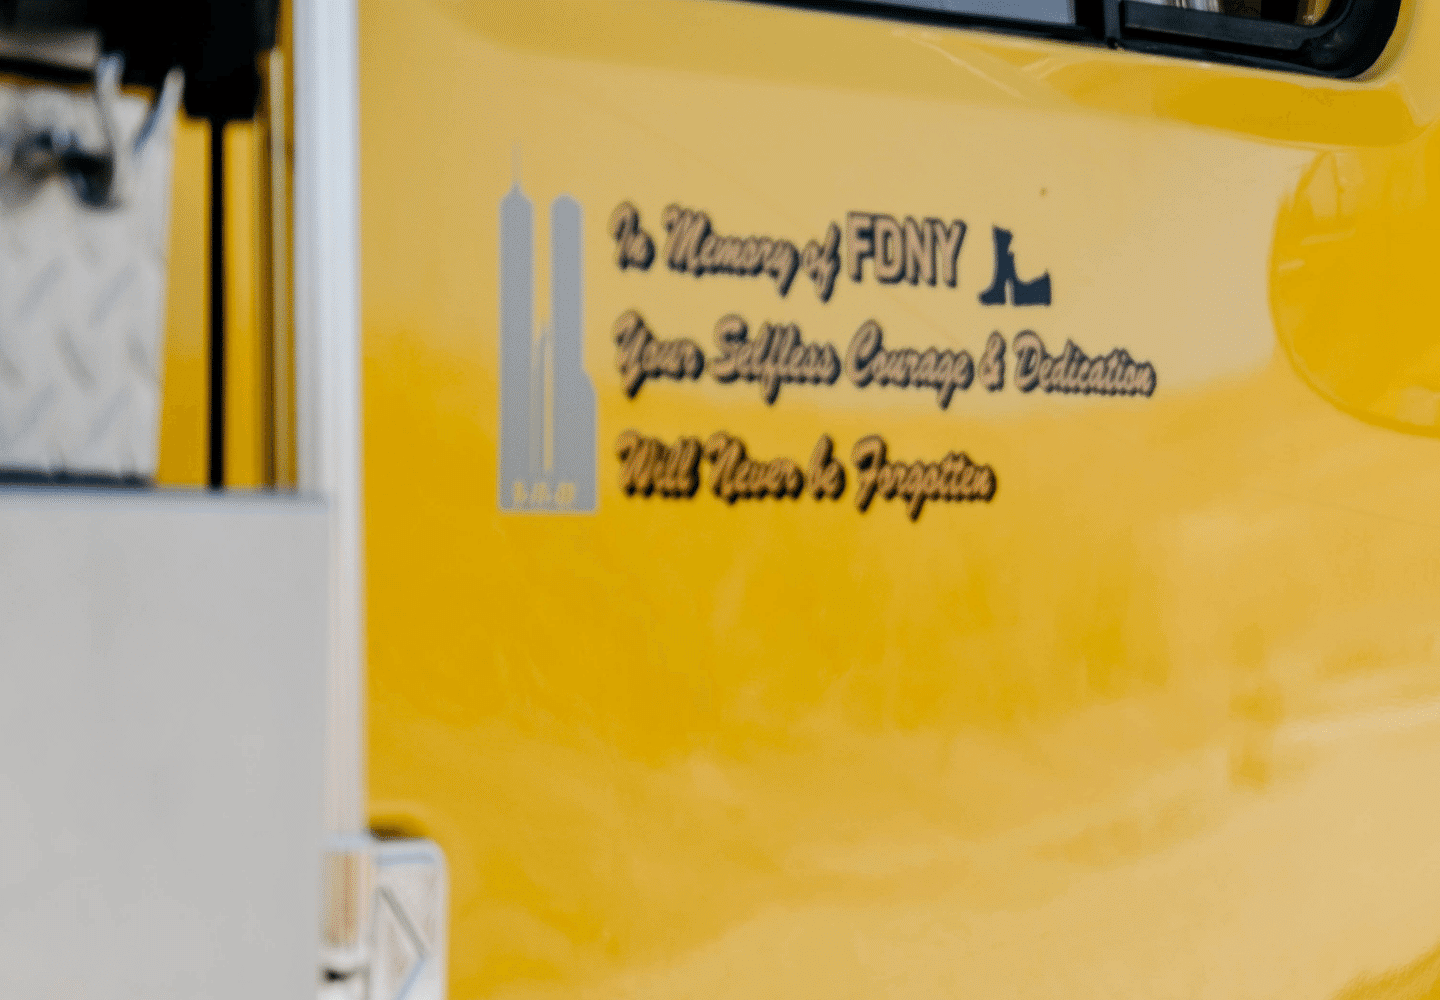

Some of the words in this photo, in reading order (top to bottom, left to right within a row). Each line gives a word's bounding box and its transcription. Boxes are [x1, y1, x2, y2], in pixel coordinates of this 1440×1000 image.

[608, 201, 655, 271] In
[661, 203, 800, 298] Memory
[801, 221, 842, 303] of
[847, 211, 966, 288] FDNY
[612, 308, 704, 400] Your
[711, 315, 842, 405] Selfless
[844, 320, 974, 410] Courage
[979, 331, 1005, 391] &
[1012, 330, 1158, 398] Dedication
[616, 429, 702, 501] Will
[703, 431, 805, 506] Never
[806, 434, 847, 500] be
[850, 433, 998, 523] Forgotten
